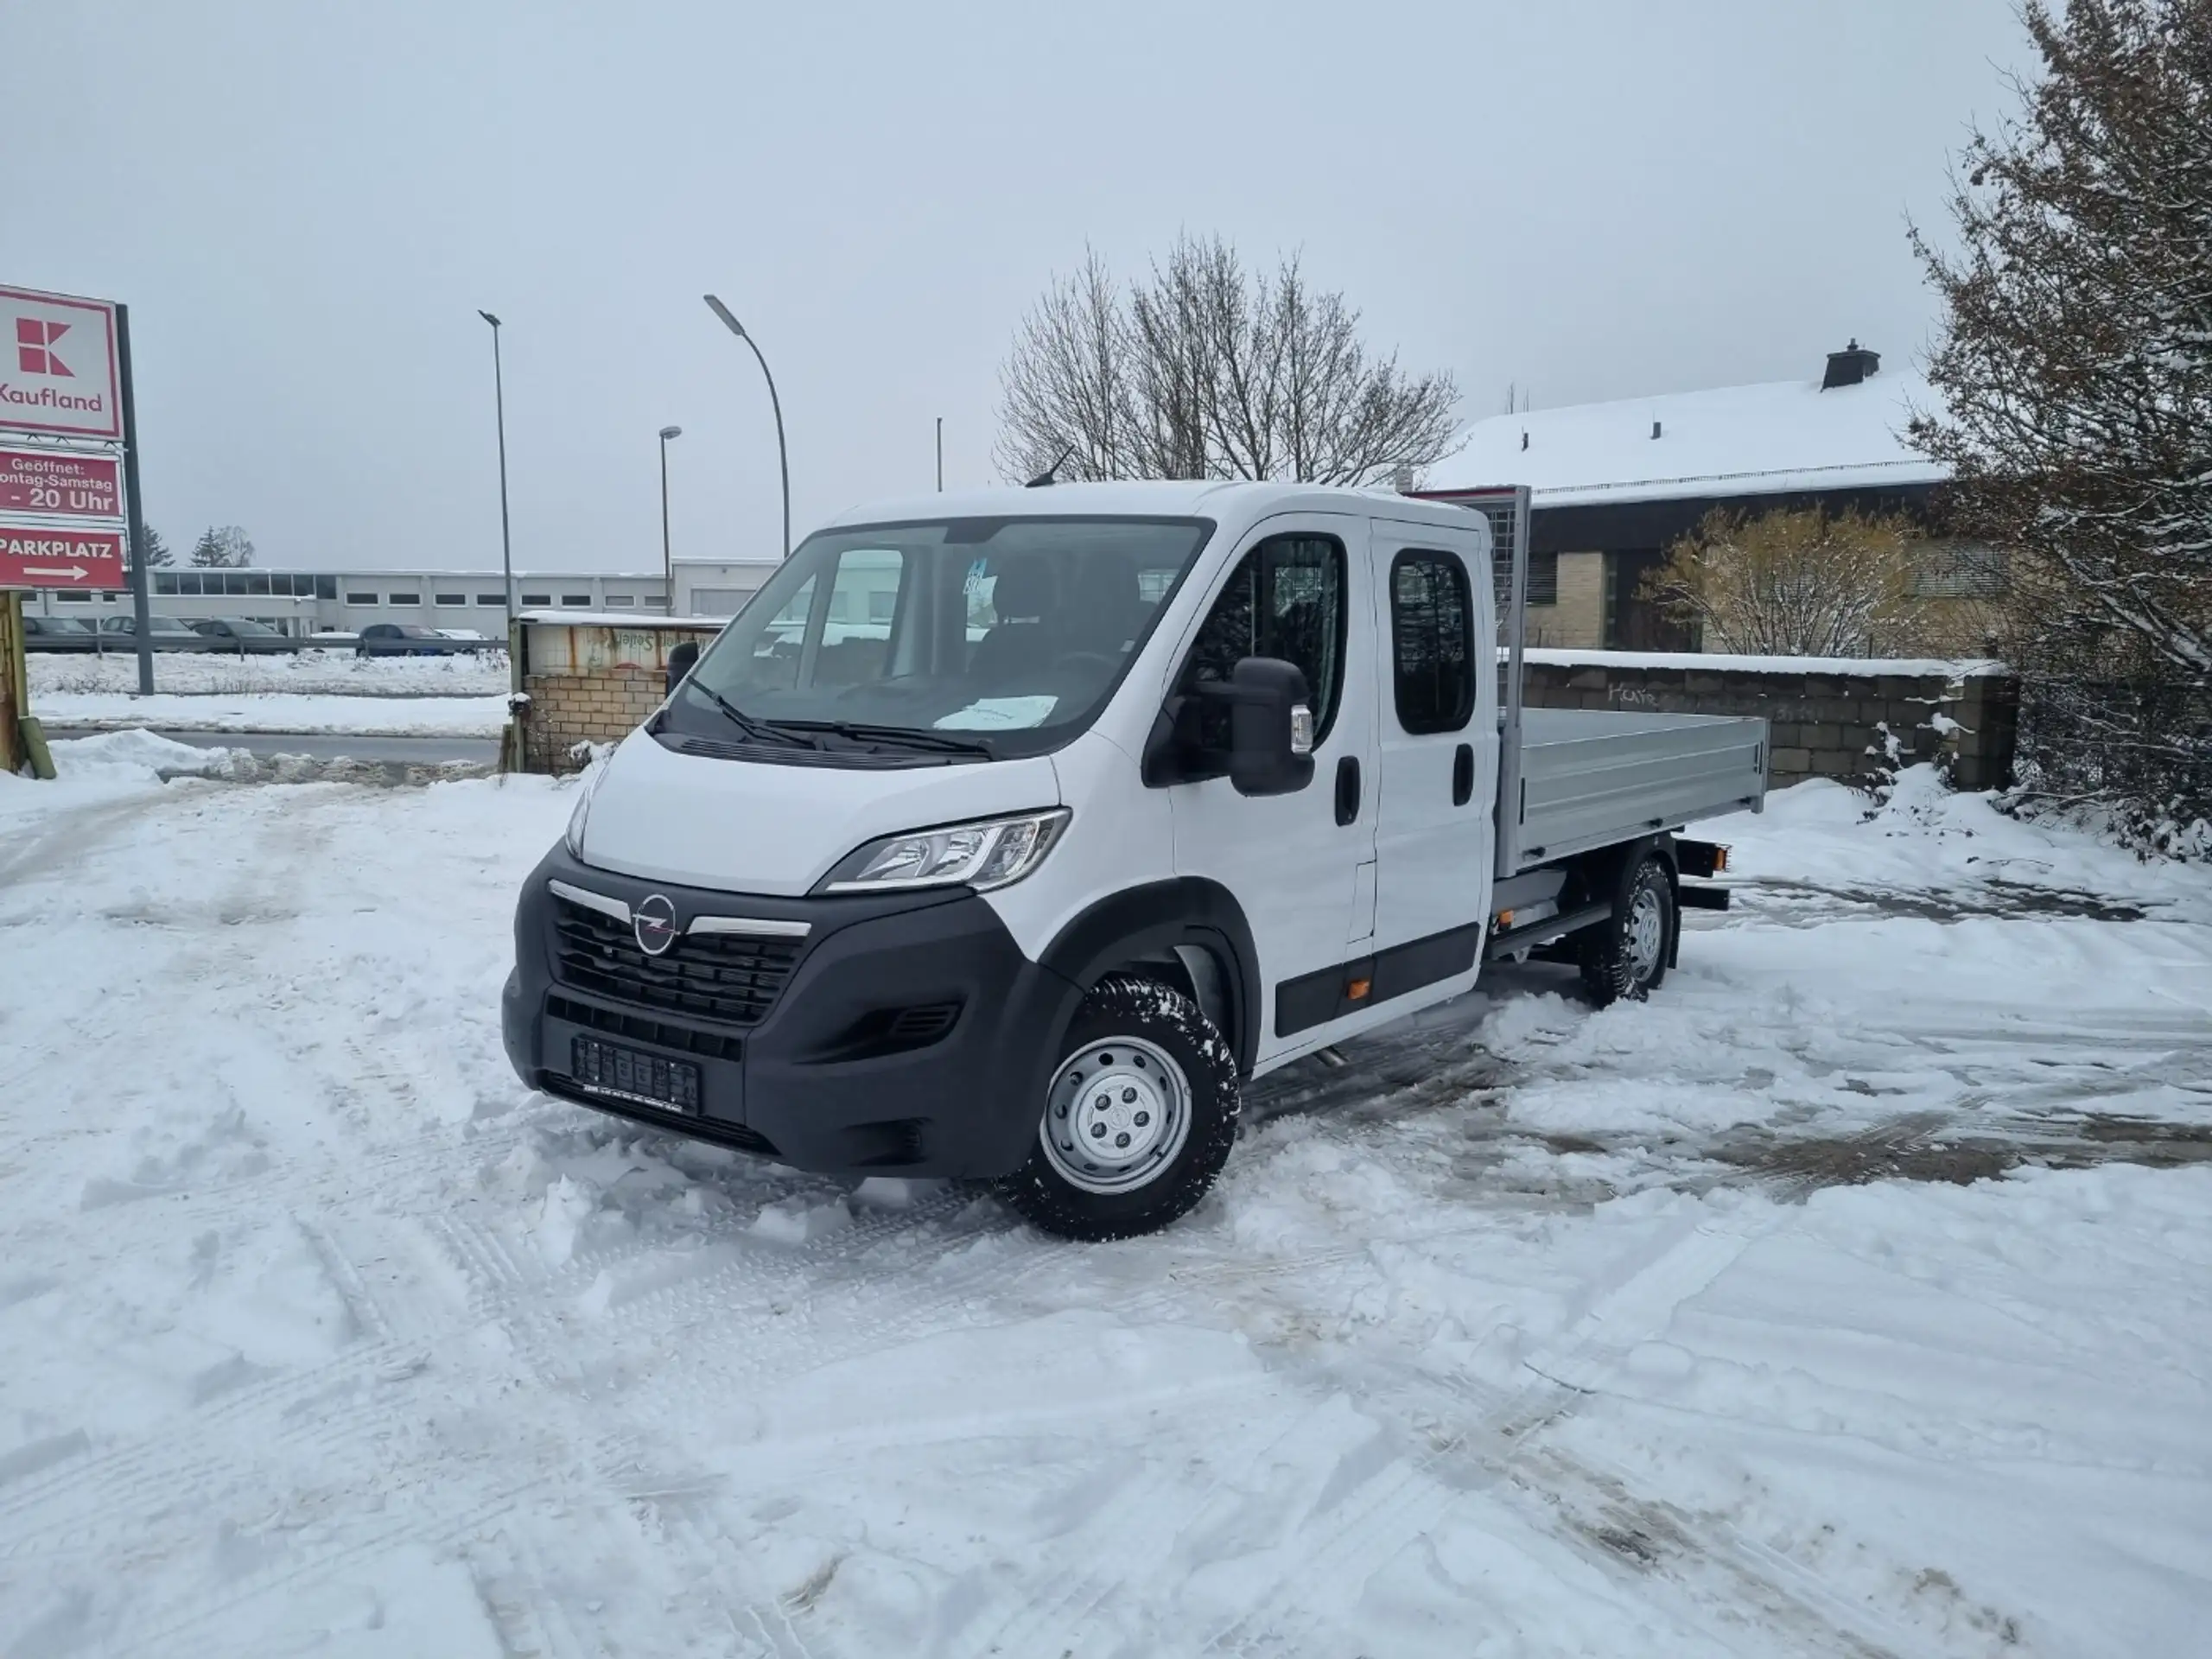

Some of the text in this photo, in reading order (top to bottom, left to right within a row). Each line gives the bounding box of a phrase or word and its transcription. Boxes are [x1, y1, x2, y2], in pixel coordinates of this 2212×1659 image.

[0, 383, 102, 412] Kaufland
[11, 457, 85, 475] Geöffnet:
[0, 472, 112, 493] ontag-Samstag
[29, 487, 60, 509] 20
[69, 490, 113, 512] Uhr
[0, 537, 113, 558] PARKPLATZ
